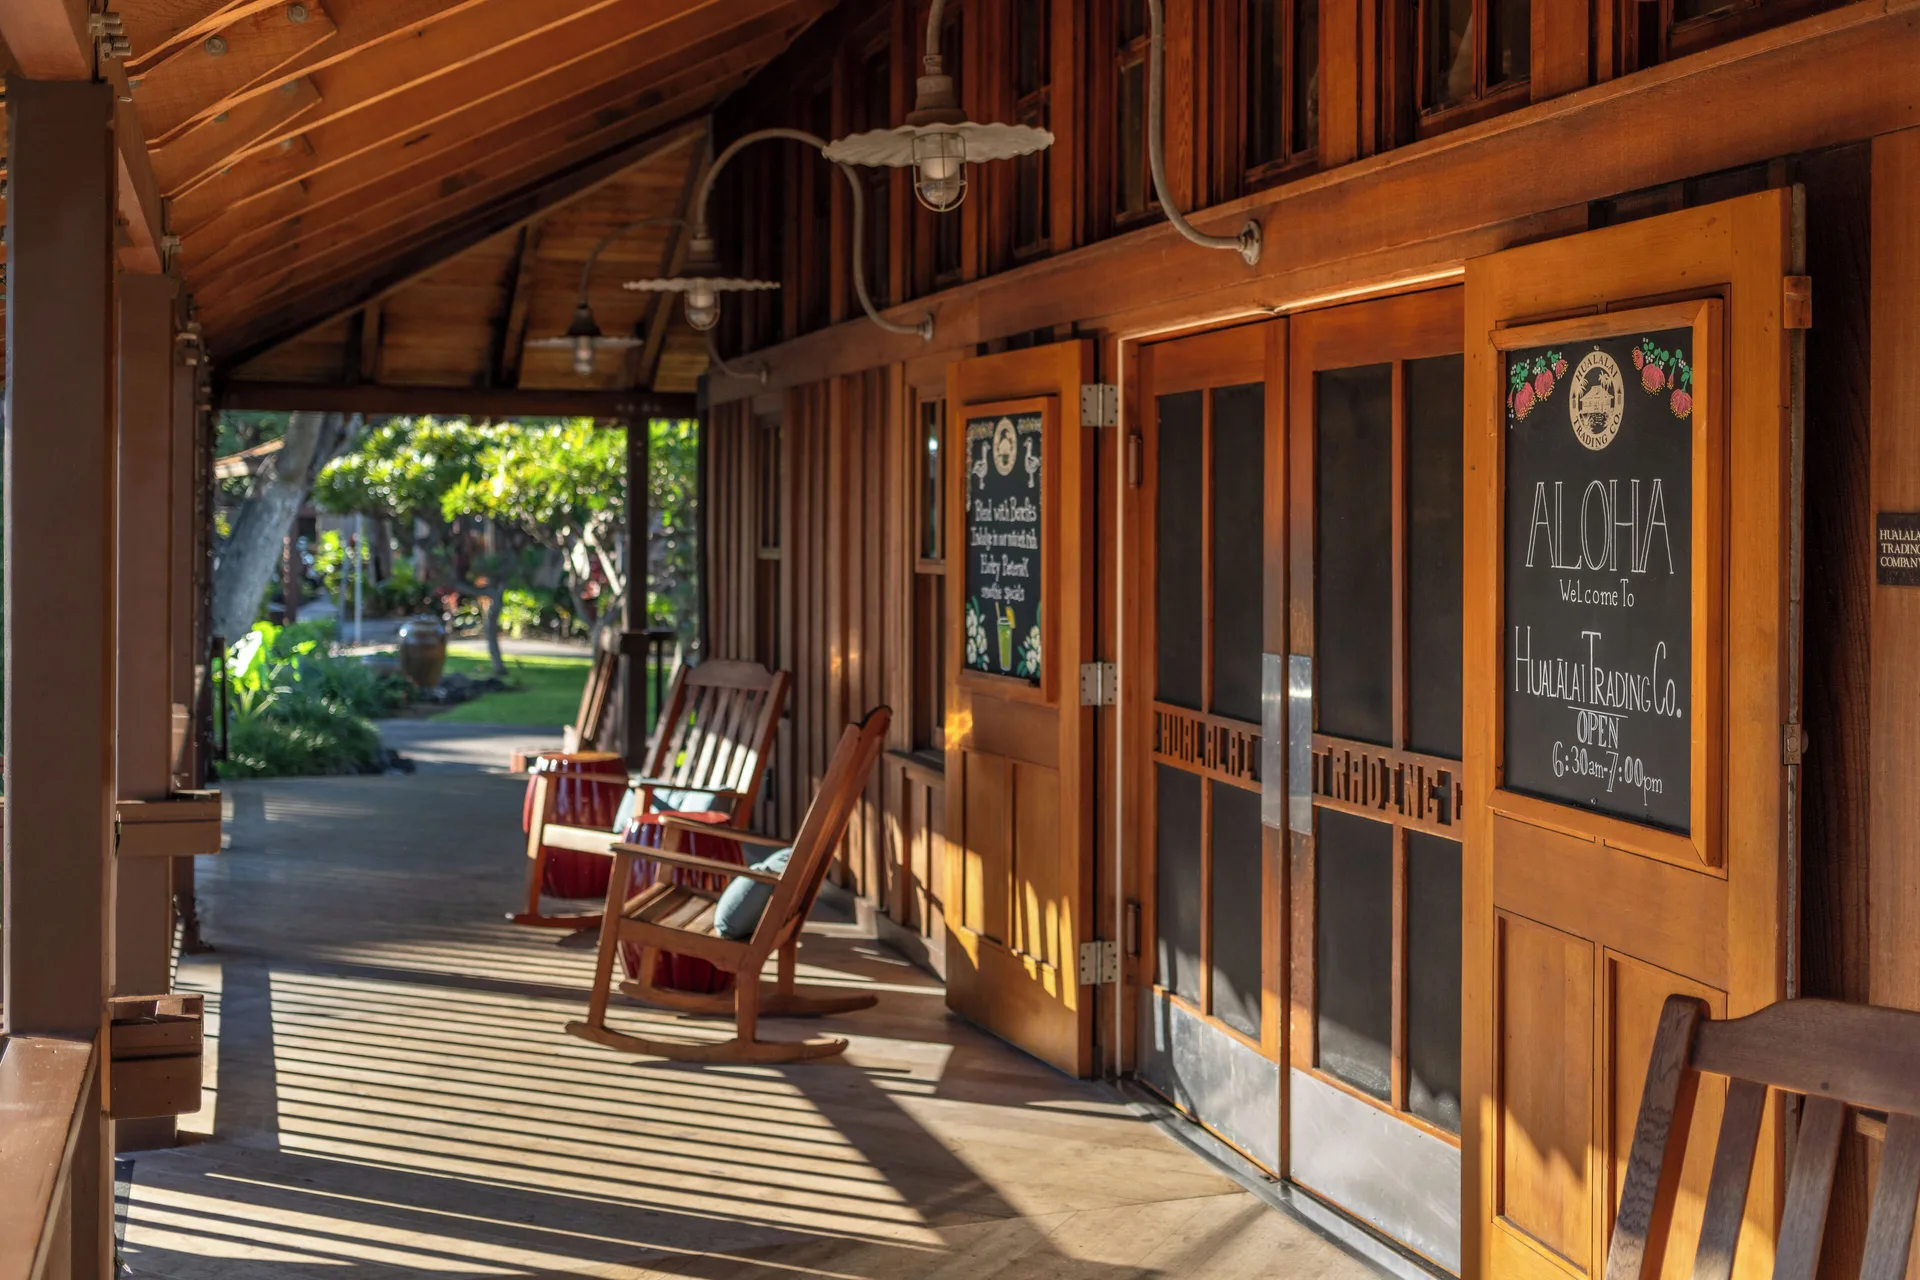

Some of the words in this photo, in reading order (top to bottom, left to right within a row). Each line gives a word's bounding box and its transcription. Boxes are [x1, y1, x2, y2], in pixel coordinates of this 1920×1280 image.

[1575, 354, 1618, 382] HUALALAI
[1573, 416, 1608, 447] TRADING
[1609, 412, 1621, 435] CO.
[975, 498, 992, 521] Blend
[993, 499, 1009, 521] with
[1009, 496, 1037, 522] Benefits
[1525, 478, 1674, 574] ALOHA
[1880, 529, 1920, 540] HUALALA
[1881, 556, 1920, 567] COMPAN
[1559, 578, 1618, 606] Welcome
[1620, 578, 1635, 607] To
[1577, 710, 1619, 749] OPEN
[1312, 745, 1441, 822] TRADING
[1552, 741, 1663, 806] 6:30am-7:00pm
